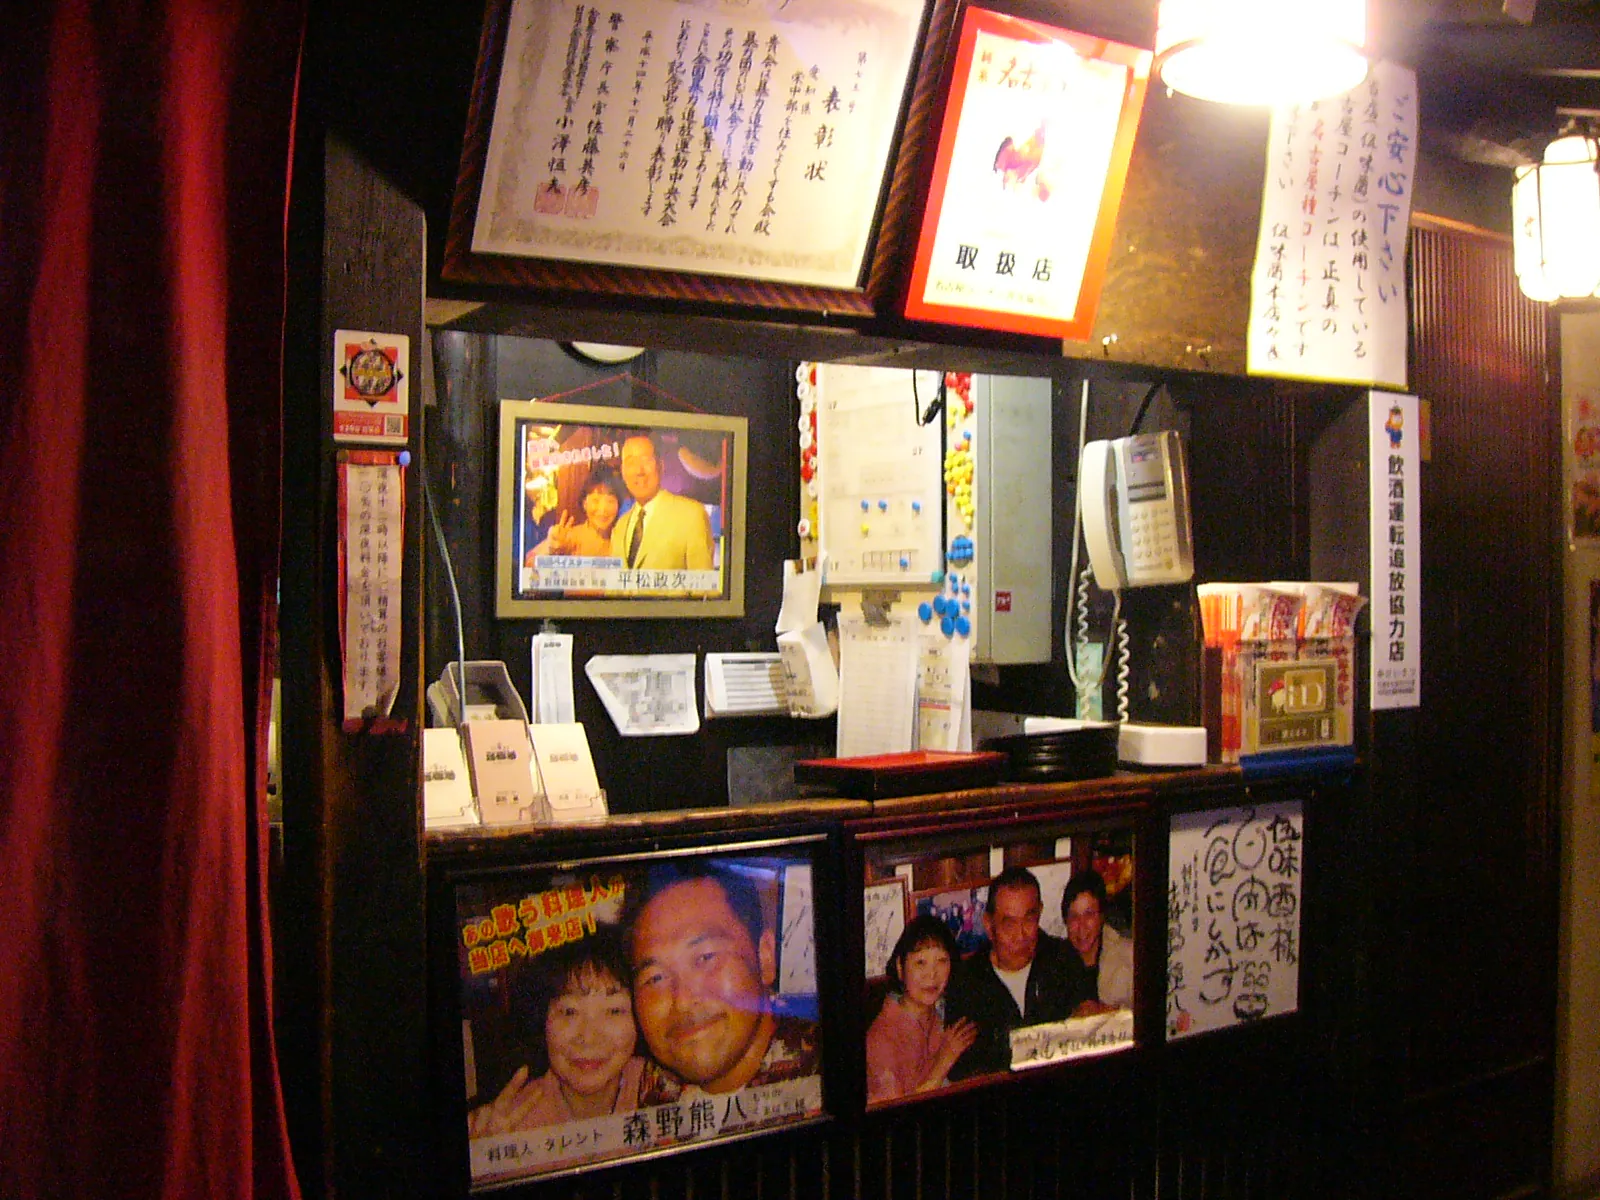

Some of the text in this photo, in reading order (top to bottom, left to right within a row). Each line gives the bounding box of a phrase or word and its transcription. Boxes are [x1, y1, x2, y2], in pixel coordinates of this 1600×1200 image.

[804, 85, 841, 182] 表彰状
[955, 244, 1053, 283] 取扱店
[618, 570, 687, 590] 平松政次
[1388, 454, 1405, 662] 飲酒運転追放協力店
[462, 874, 626, 948] あの歌う料理人が
[622, 1096, 748, 1146] 森野熊八
